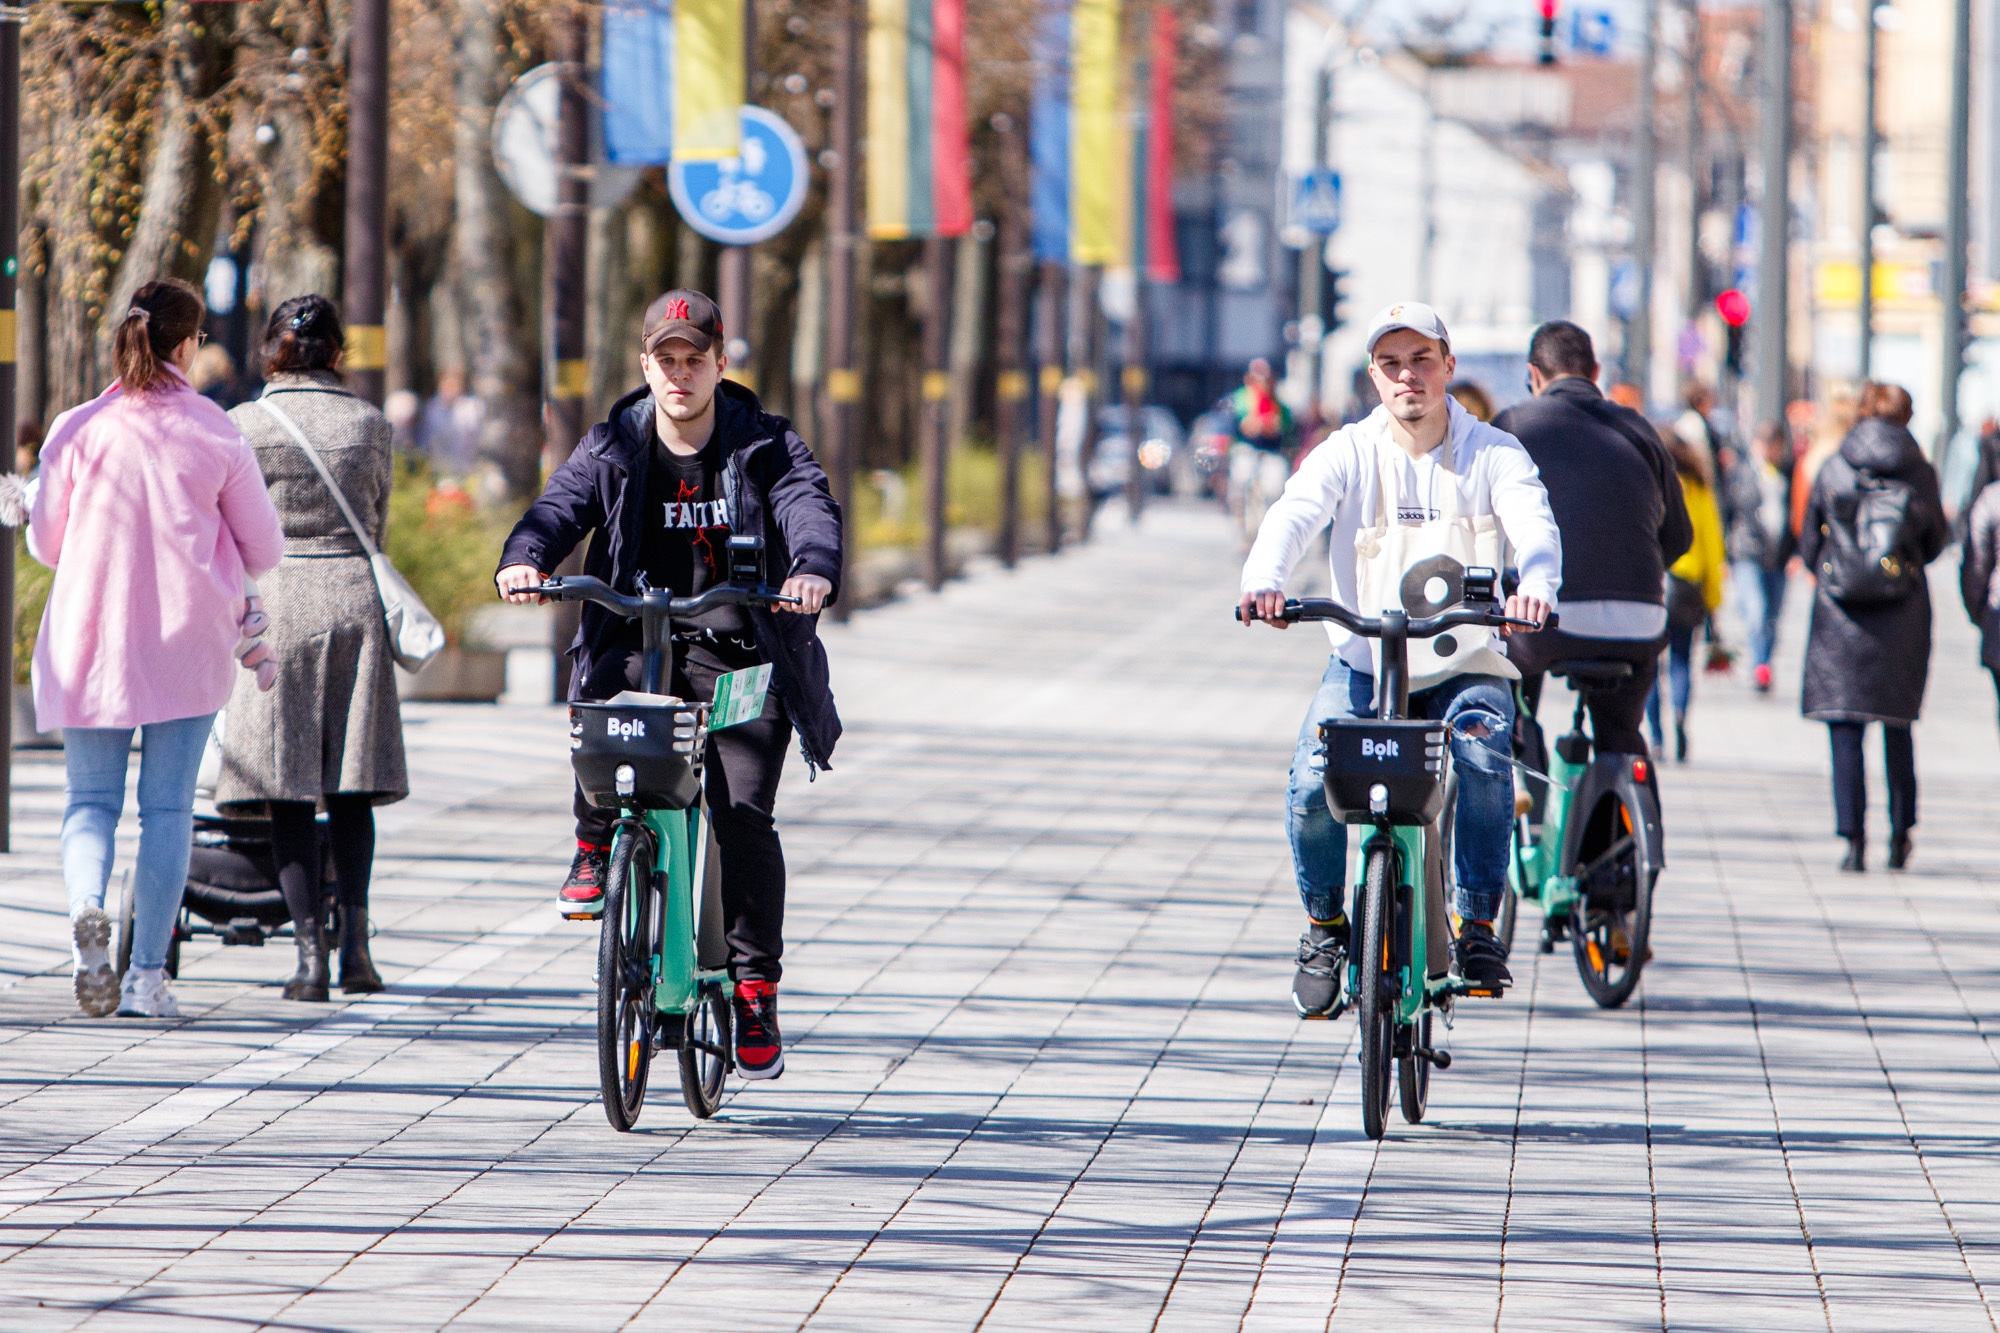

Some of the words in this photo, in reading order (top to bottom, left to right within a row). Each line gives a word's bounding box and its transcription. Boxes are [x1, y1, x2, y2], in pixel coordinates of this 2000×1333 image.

[665, 298, 689, 320] NY
[662, 498, 729, 529] FAITH
[607, 717, 645, 741] Bolt
[1361, 738, 1399, 761] Bolt
